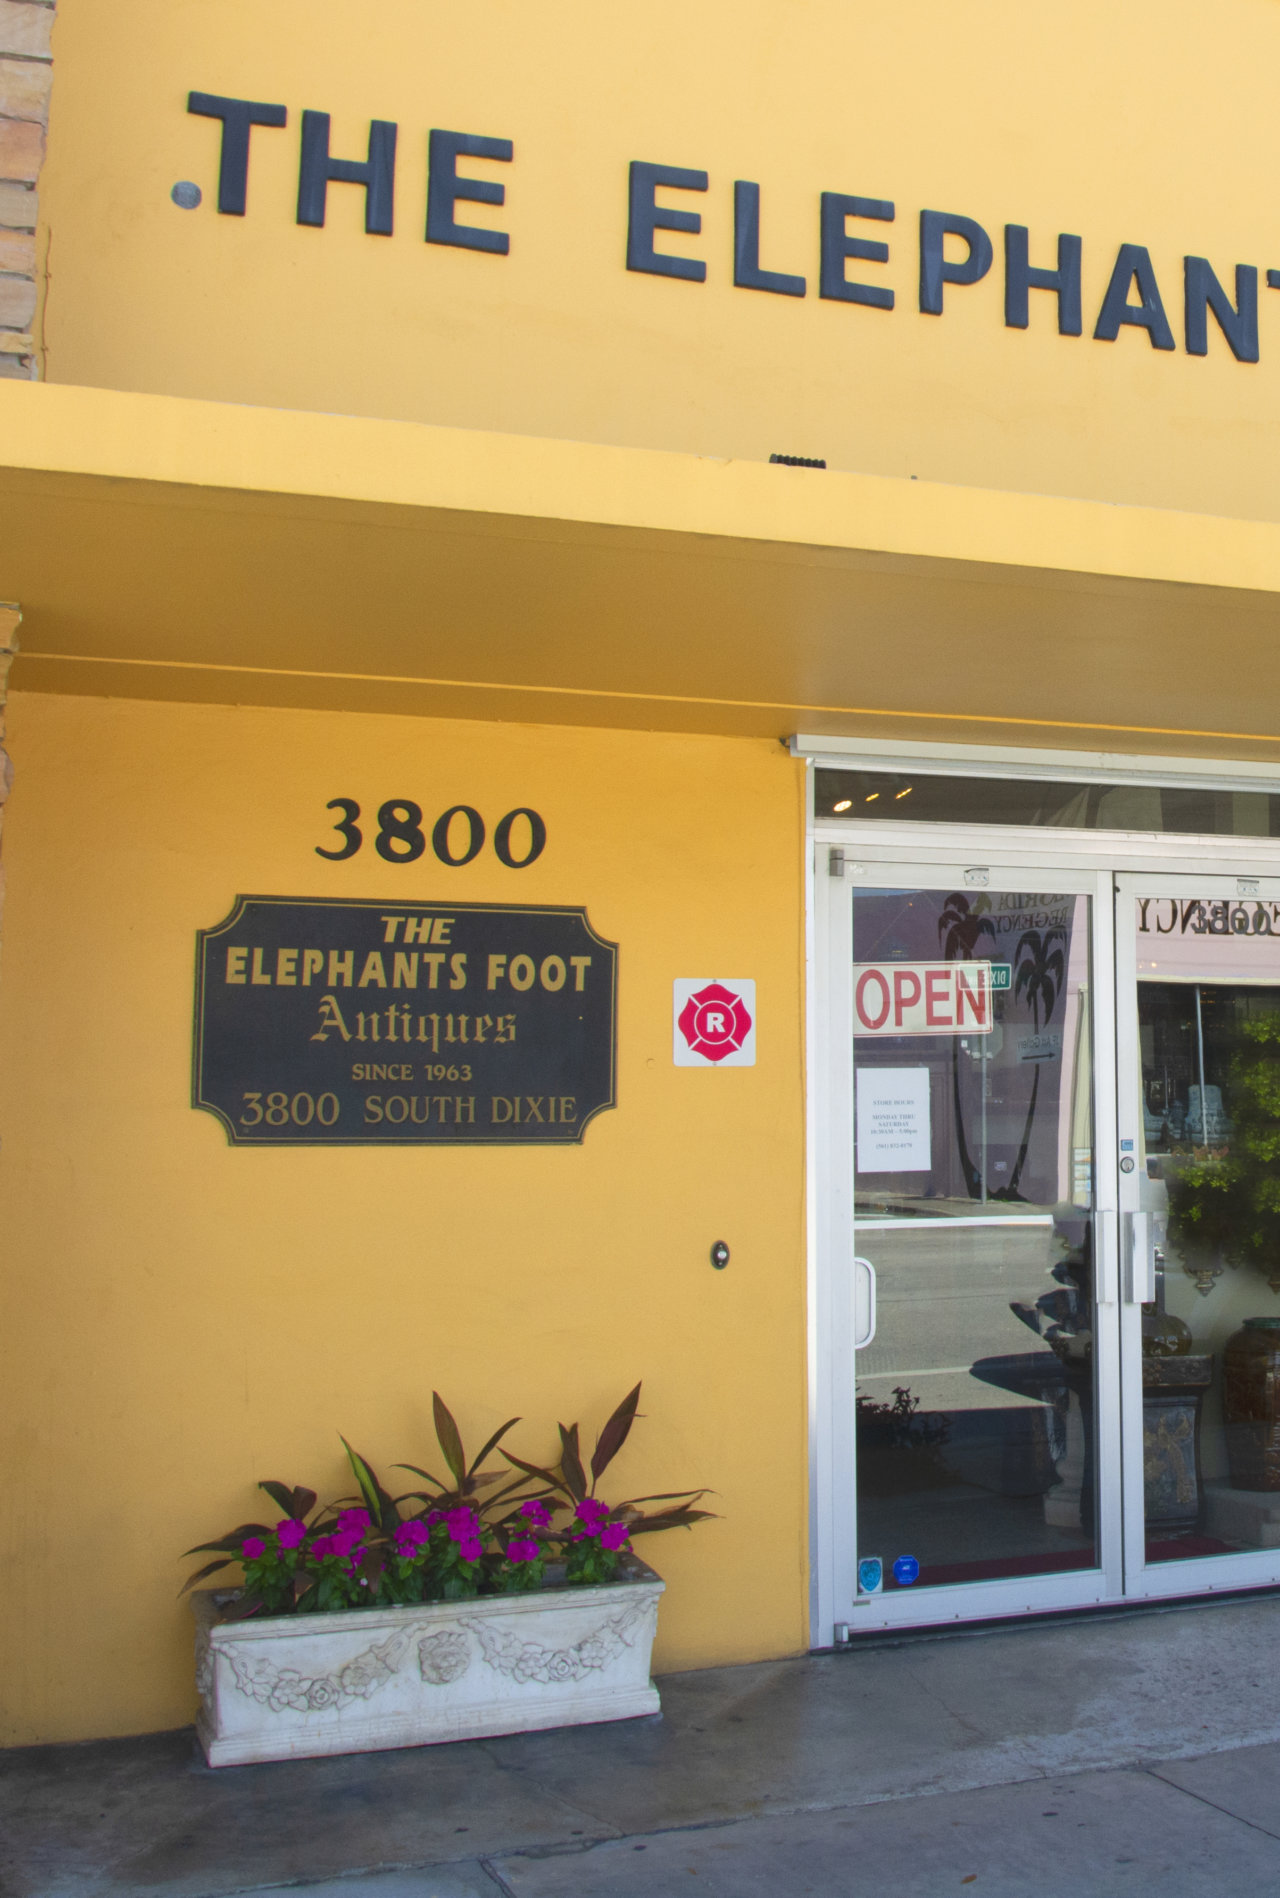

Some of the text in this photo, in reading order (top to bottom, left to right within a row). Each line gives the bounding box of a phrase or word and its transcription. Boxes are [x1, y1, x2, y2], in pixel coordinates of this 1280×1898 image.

[186, 90, 514, 257] THE
[314, 797, 548, 869] 3800
[380, 915, 456, 946] THE
[1189, 904, 1272, 936] 3800
[224, 946, 593, 993] ELEPHANTS FOOT
[855, 968, 987, 1031] OPEN
[309, 994, 518, 1054] Antiques
[705, 1011, 727, 1034] R
[351, 1063, 473, 1082] SINCE 1963
[239, 1091, 579, 1127] 3800 SOUTH DIXIE
